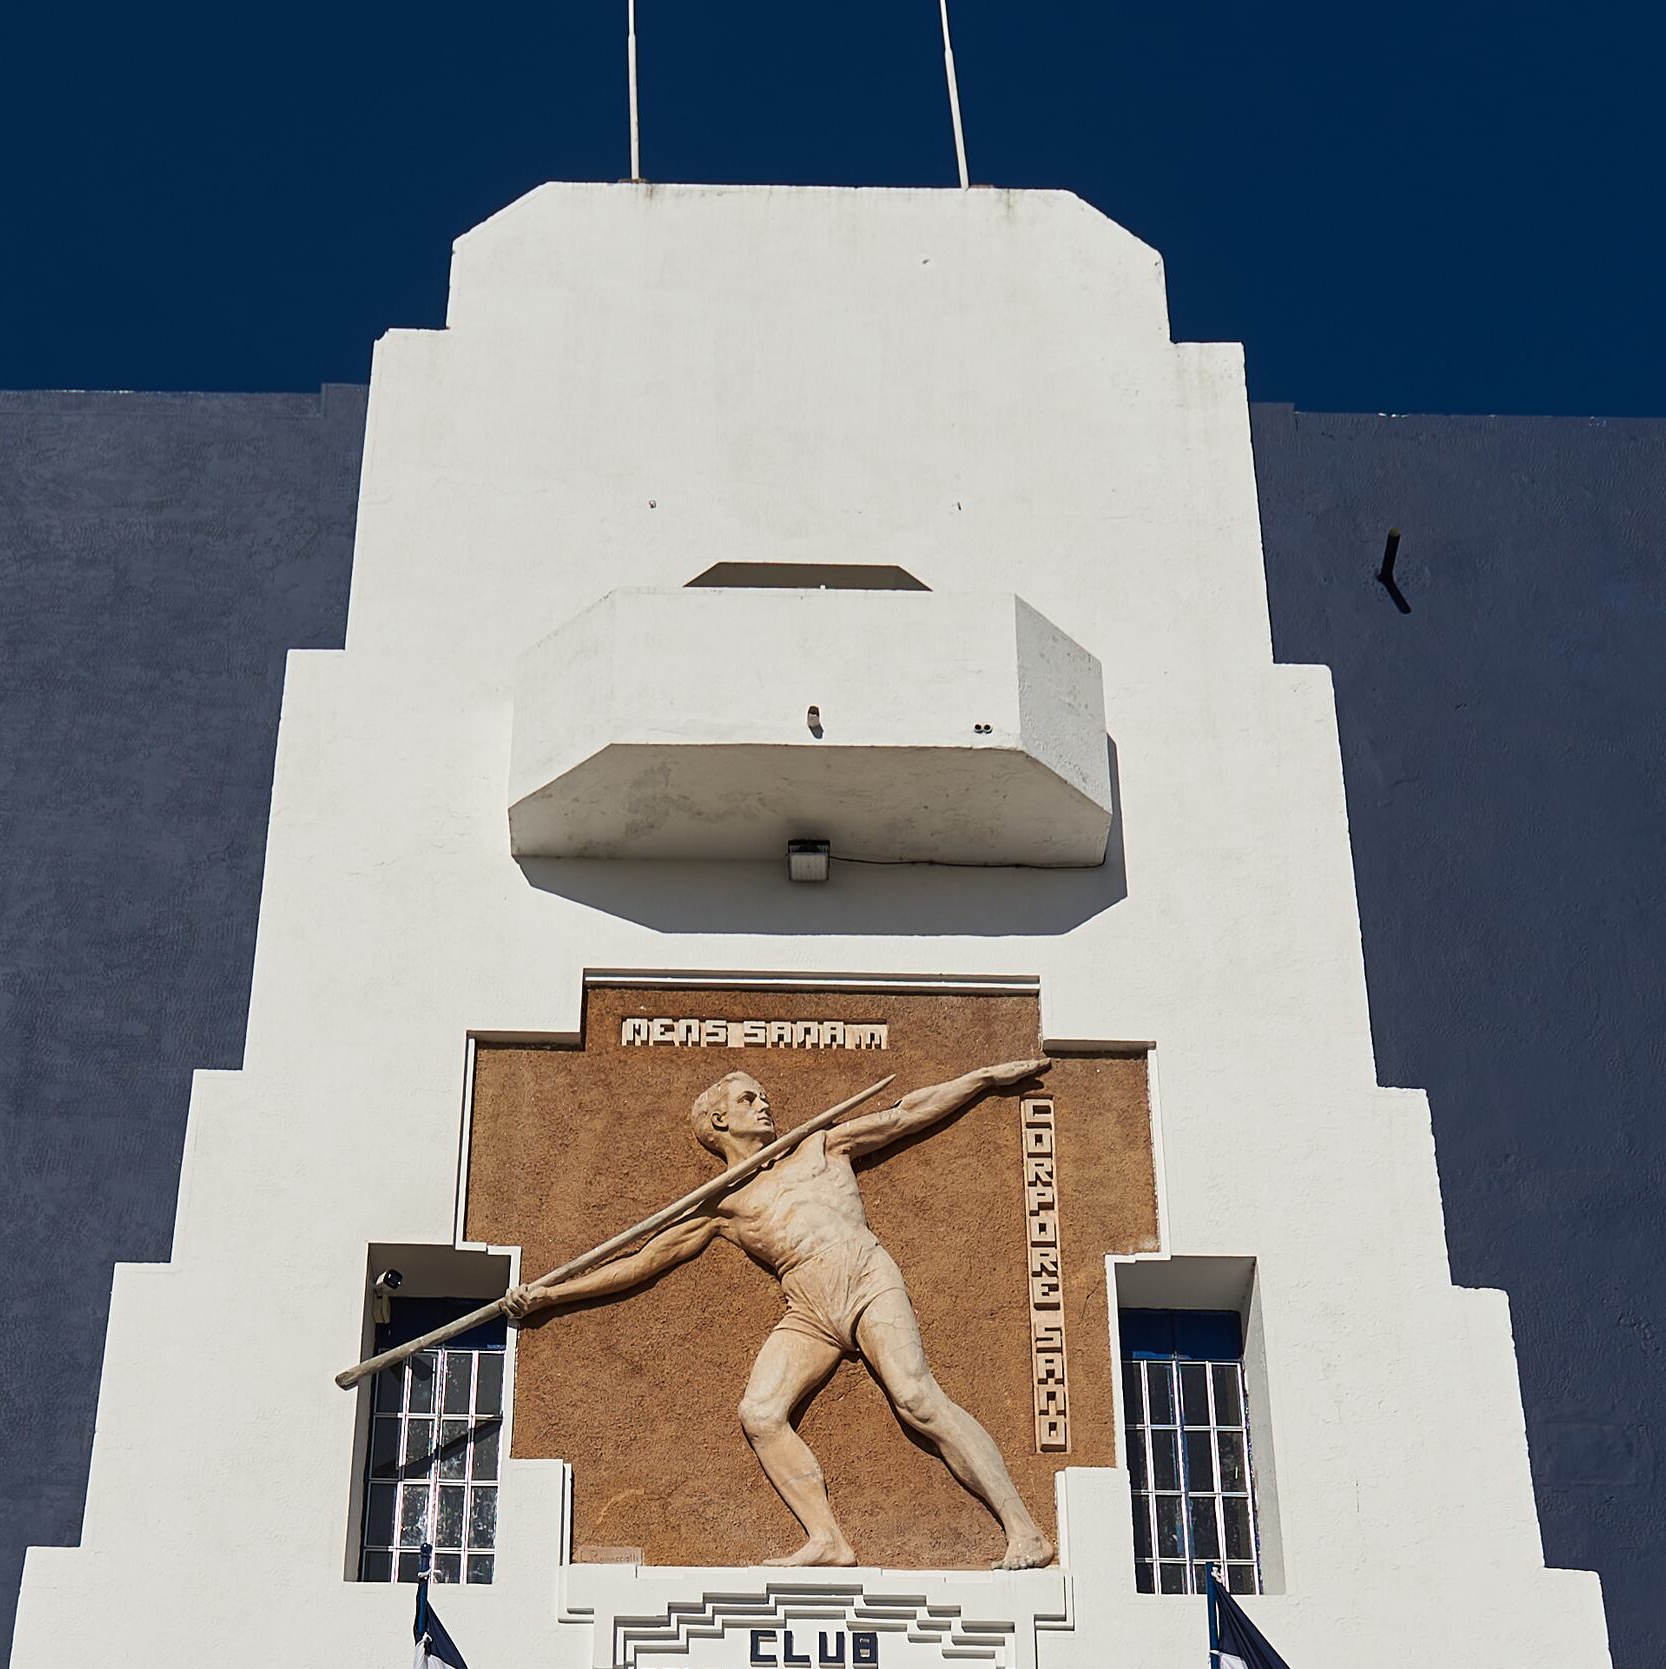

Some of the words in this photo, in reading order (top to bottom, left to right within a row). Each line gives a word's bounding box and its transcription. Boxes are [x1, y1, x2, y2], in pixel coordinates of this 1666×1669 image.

[626, 1017, 727, 1044] MENS
[743, 1020, 845, 1046] SANA
[1024, 1098, 1061, 1308] CORPORE
[1035, 1322, 1067, 1450] SANO
[749, 1629, 879, 1669] CLUB
